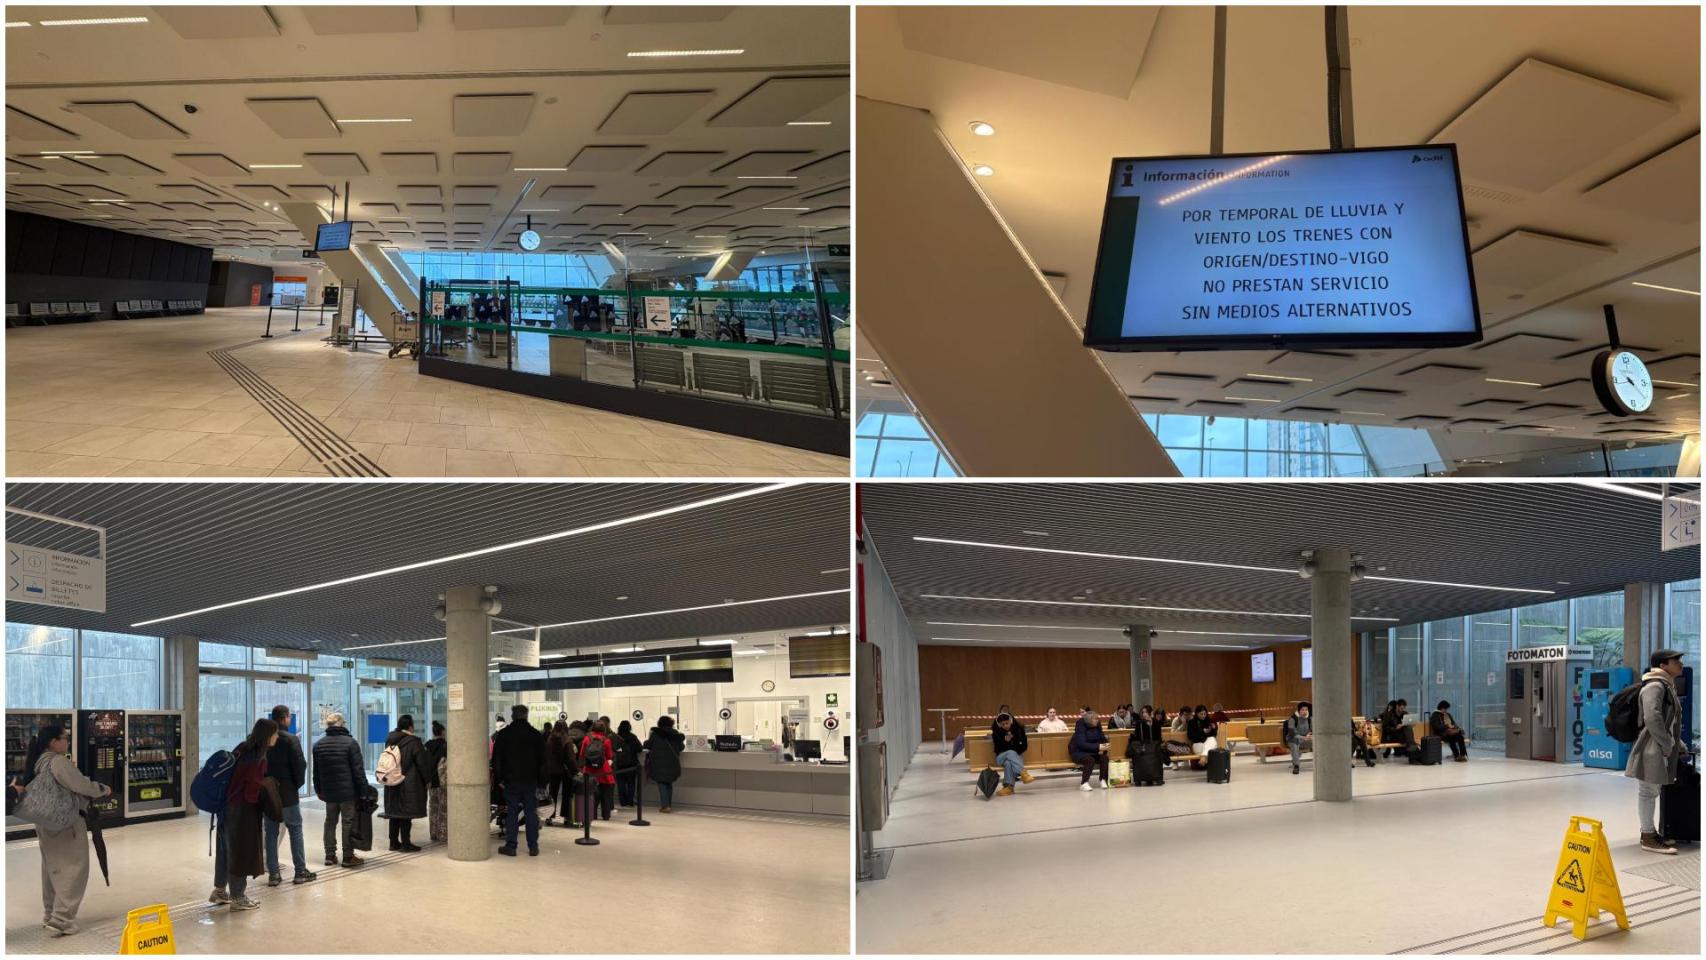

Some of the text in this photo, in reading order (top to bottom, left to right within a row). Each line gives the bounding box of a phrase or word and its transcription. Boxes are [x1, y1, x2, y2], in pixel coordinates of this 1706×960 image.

[1143, 168, 1290, 182] Información FORMATION
[1182, 202, 1405, 222] POR TEMPORAL DE LLUVIA Y
[1194, 226, 1393, 245] VIENTO LOS TRENES CON
[1203, 275, 1389, 293] NO PRESTAN SERVICIO
[1182, 301, 1413, 320] SIN MEDIOS ALTERNATIVOS
[1507, 647, 1564, 661] FOTOMATON
[1589, 748, 1613, 759] alsa
[1568, 841, 1591, 855] CAUTION
[137, 934, 169, 950] CAUTION
